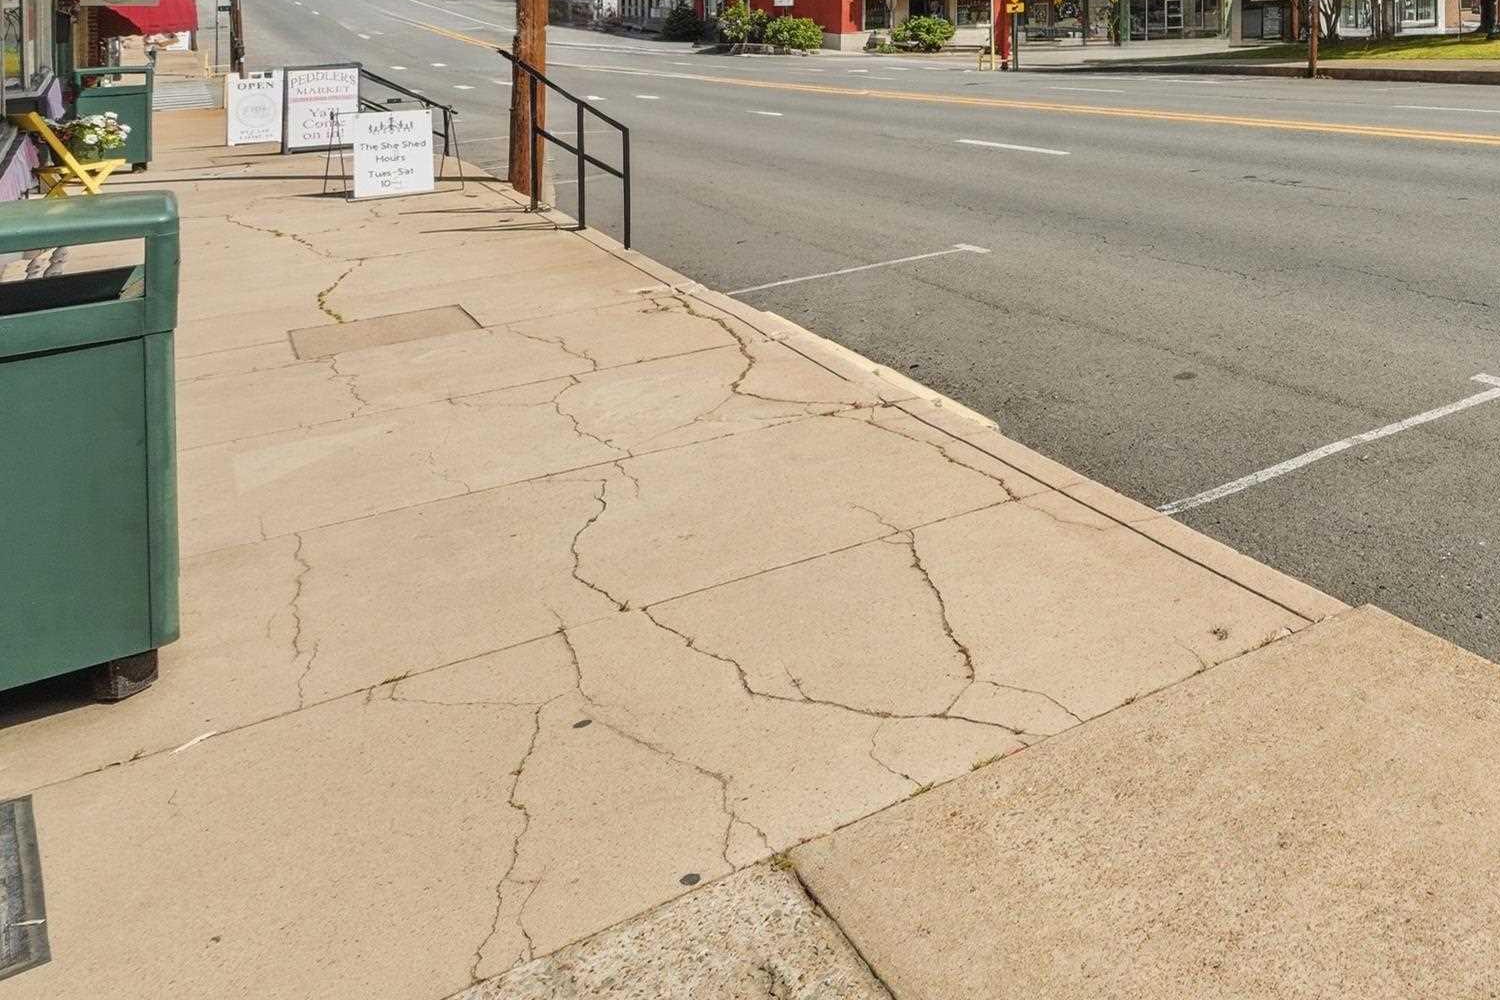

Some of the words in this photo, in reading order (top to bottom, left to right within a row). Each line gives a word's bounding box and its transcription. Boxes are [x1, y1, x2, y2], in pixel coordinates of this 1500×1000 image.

[290, 71, 356, 88] PEDDLERS
[237, 81, 274, 90] OPEN
[296, 85, 350, 96] MARKET
[361, 143, 379, 153] The
[380, 141, 400, 151] She
[401, 140, 427, 149] Shed
[376, 154, 406, 163] Hours
